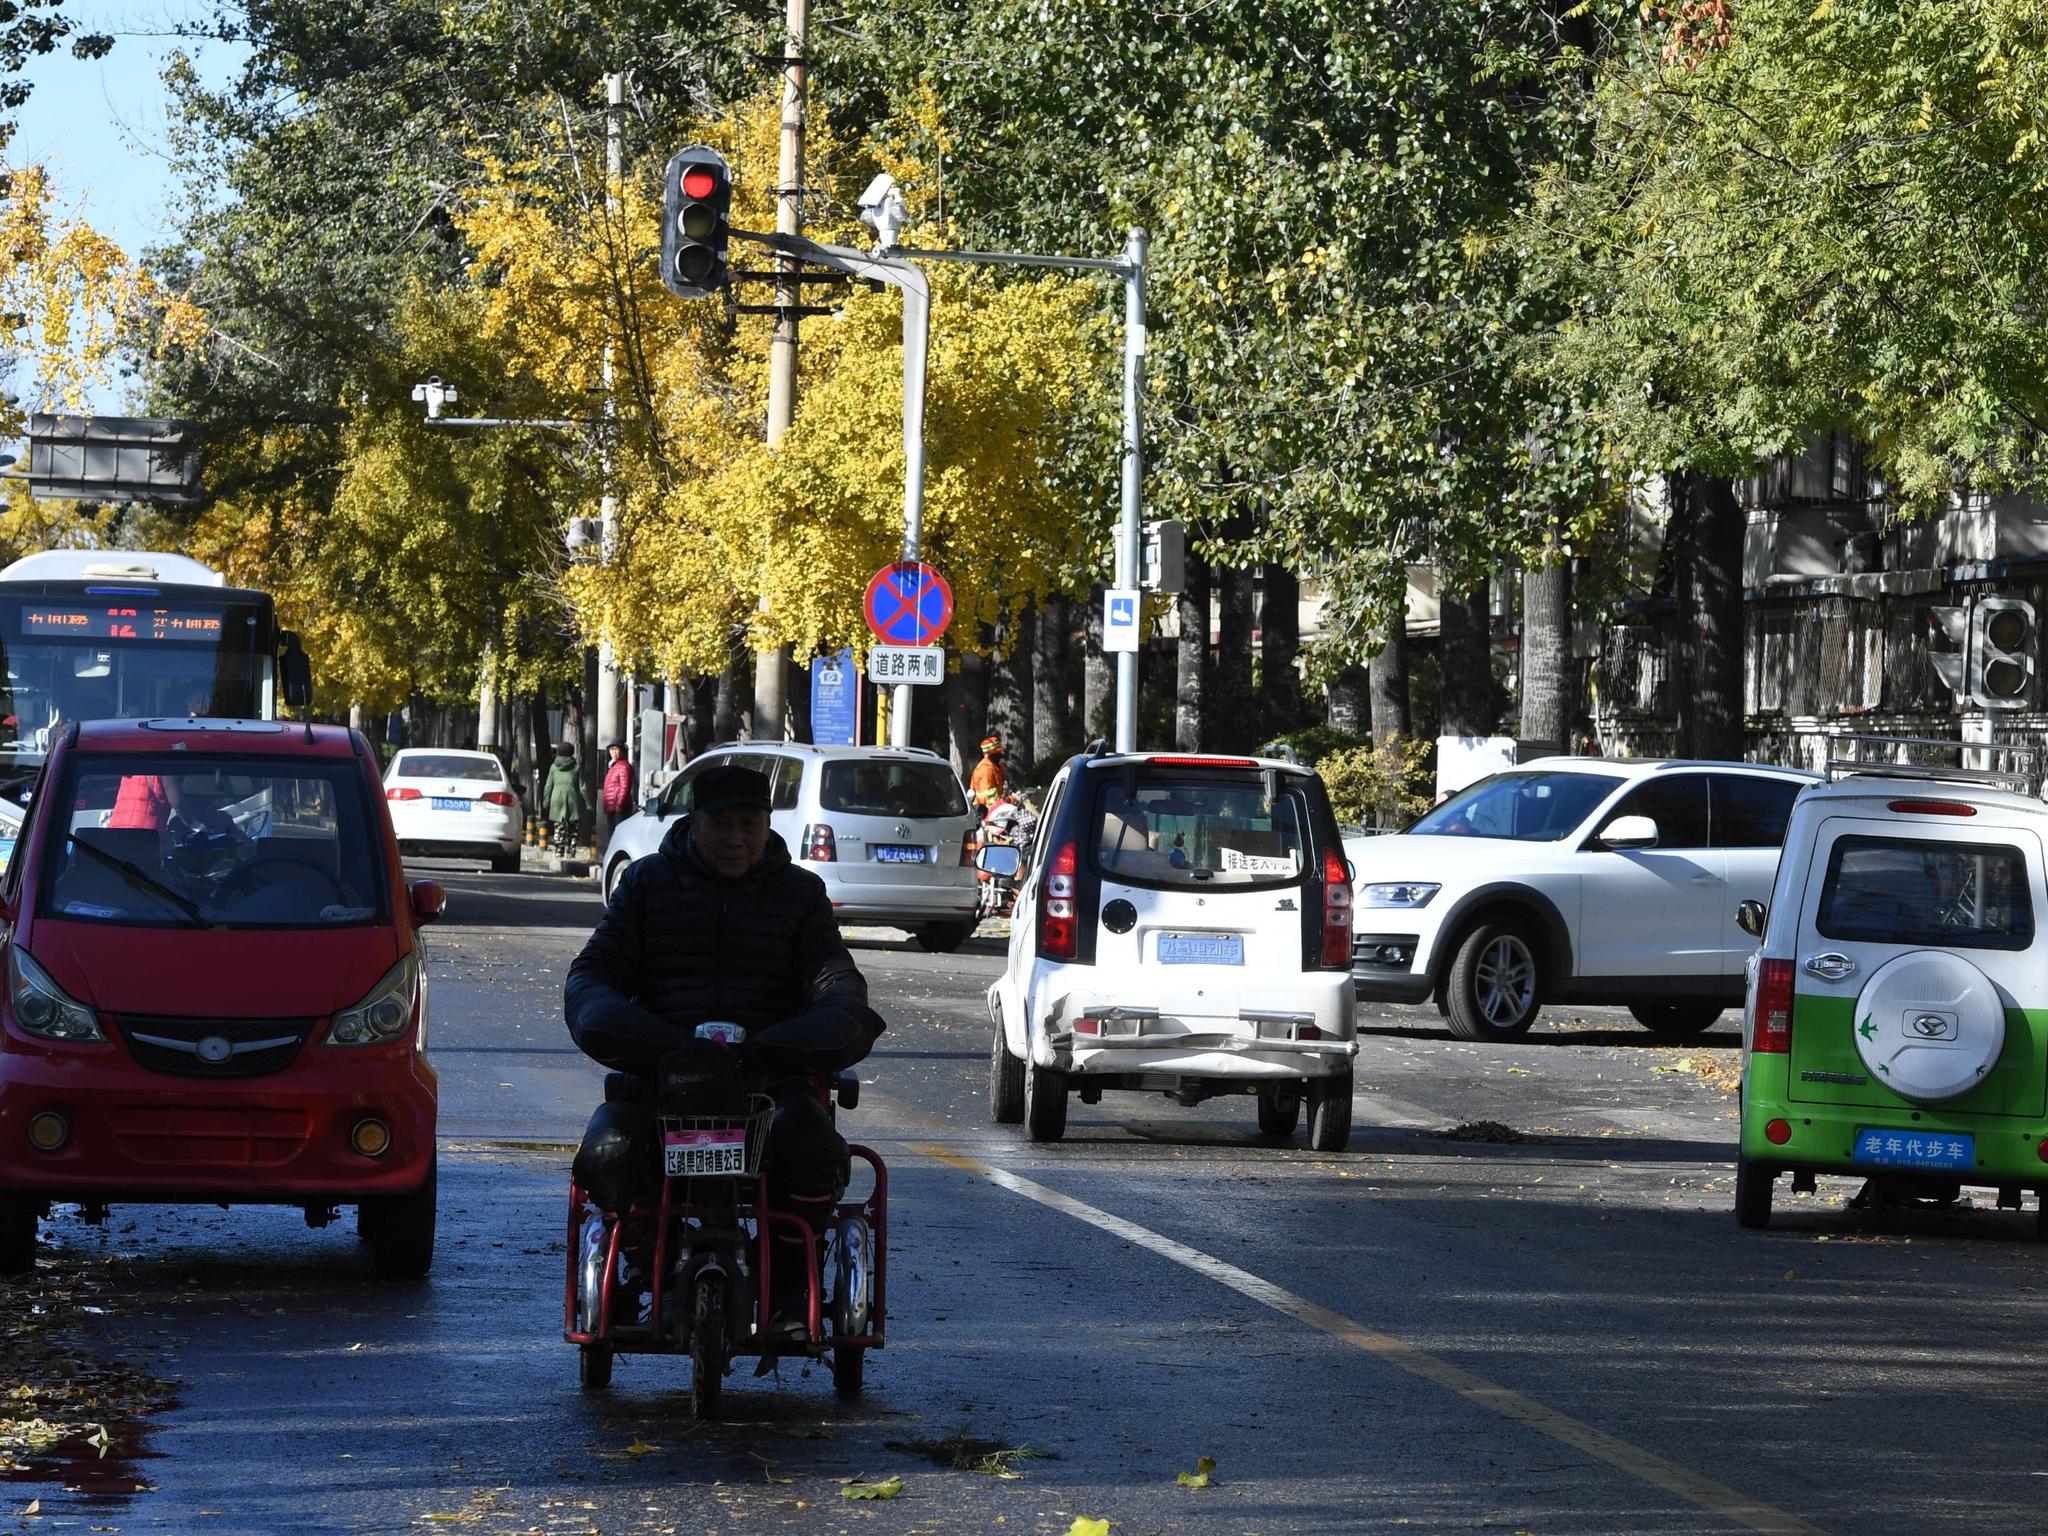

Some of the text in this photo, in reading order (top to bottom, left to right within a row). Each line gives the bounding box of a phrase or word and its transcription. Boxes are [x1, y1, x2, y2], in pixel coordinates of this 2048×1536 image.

[875, 652, 938, 677] 道路两侧
[1865, 1137, 1964, 1160] 老年代步车
